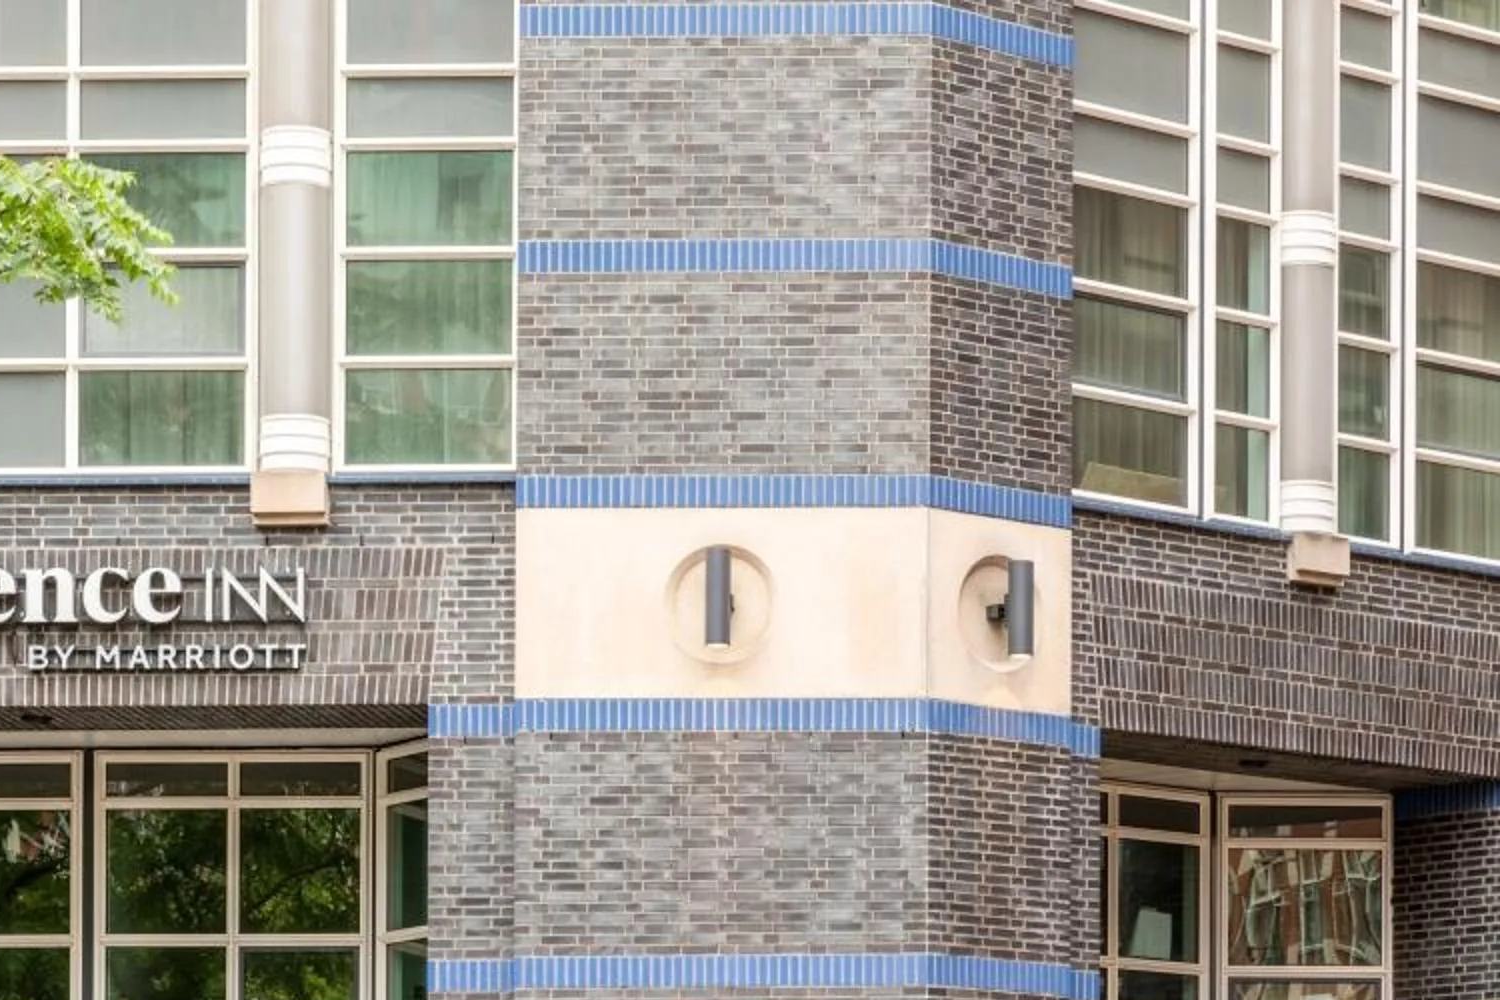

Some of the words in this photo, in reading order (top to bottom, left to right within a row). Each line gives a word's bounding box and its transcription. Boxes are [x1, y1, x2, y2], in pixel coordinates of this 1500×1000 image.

[204, 566, 306, 623] INN
[28, 644, 76, 670] BY
[94, 643, 307, 670] MARRIOTT
